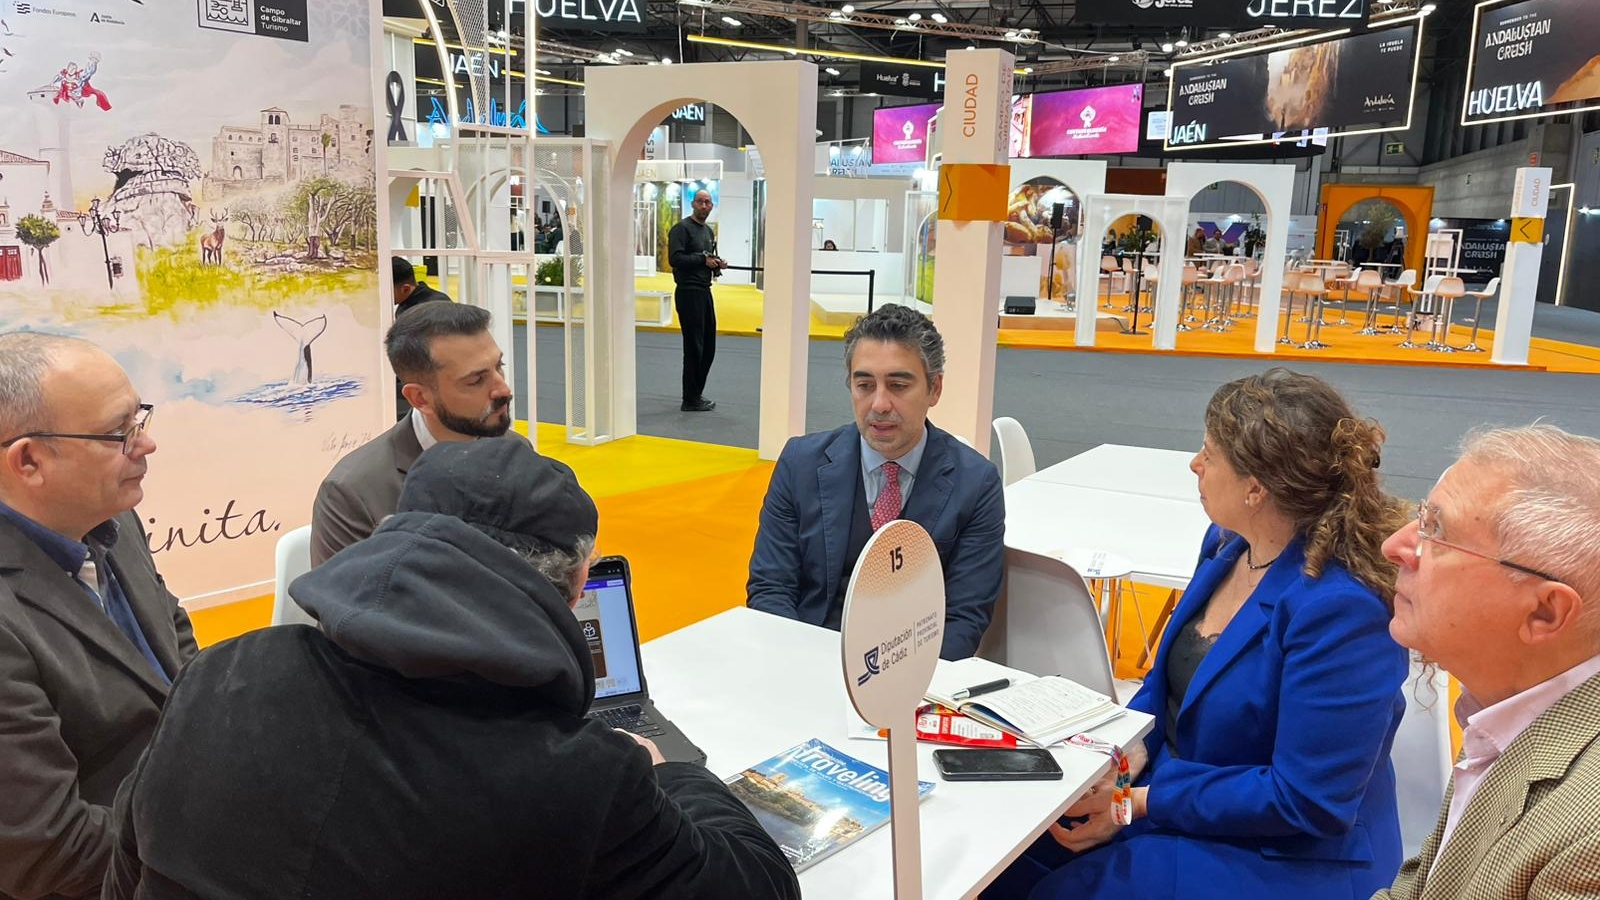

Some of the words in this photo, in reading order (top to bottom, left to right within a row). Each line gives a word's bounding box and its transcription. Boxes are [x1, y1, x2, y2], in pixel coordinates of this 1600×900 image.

[260, 6, 285, 15] Campo
[271, 15, 302, 26] Gibraltar
[261, 22, 289, 32] Turismo
[963, 73, 978, 137] CIUDAD
[1467, 80, 1543, 116] HUELVA
[1169, 120, 1207, 145] JAÉN
[146, 500, 280, 554] inita.
[890, 546, 903, 573] 15
[881, 628, 912, 655] Diputación
[882, 658, 889, 671] de
[892, 647, 907, 664] Cádiz
